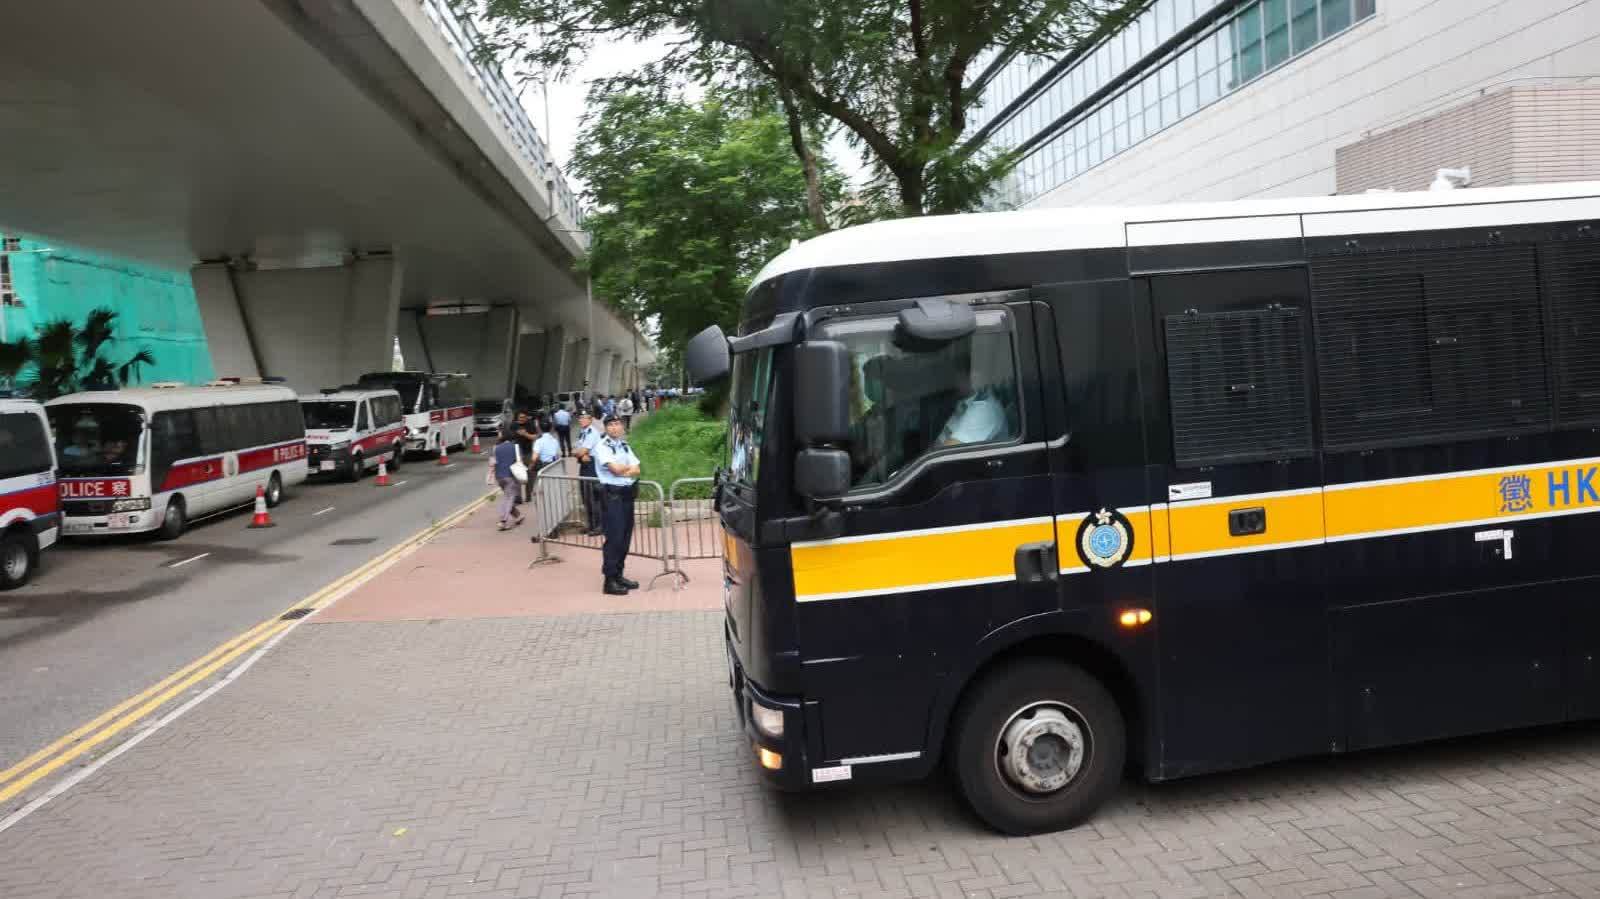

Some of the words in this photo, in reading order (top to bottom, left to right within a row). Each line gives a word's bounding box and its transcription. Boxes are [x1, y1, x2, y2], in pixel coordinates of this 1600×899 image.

[59, 482, 105, 497] OLICE
[1499, 474, 1533, 512] 懲
[1548, 468, 1600, 506] HK
